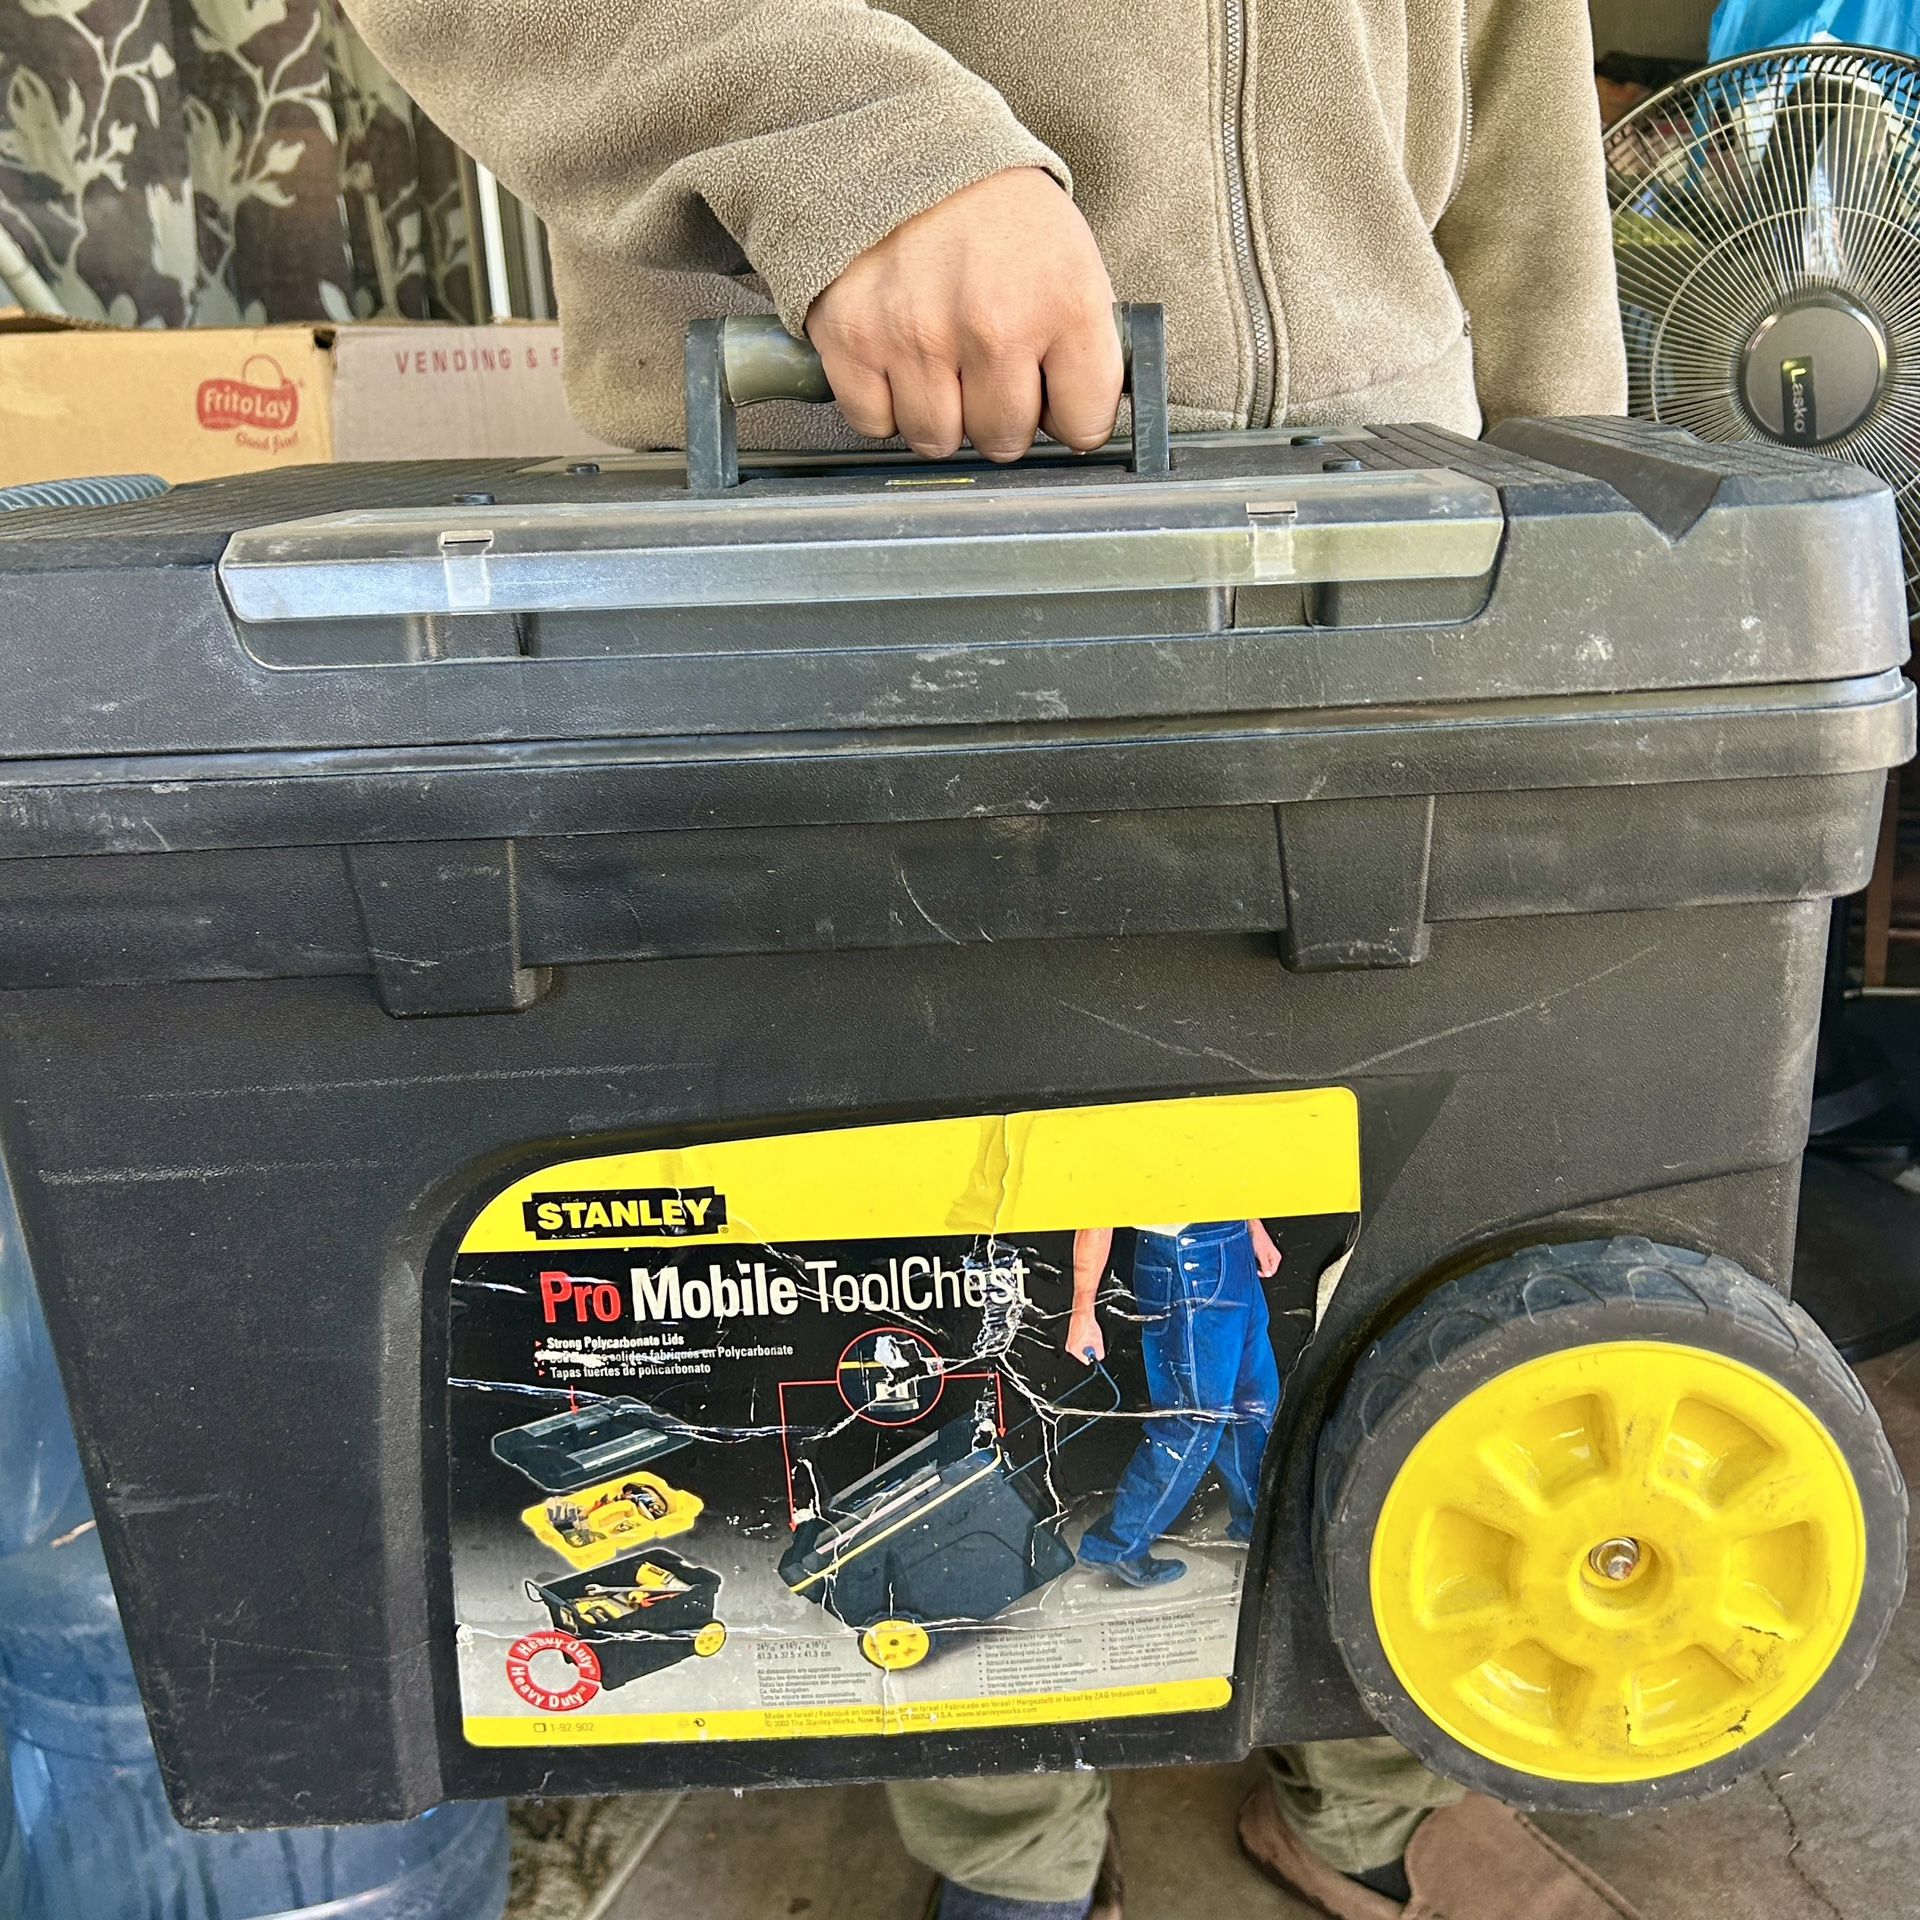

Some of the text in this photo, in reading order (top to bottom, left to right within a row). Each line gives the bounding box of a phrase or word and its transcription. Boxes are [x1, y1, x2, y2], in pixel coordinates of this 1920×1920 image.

[395, 347, 512, 374] VENDING
[1790, 368, 1807, 433] Lasko
[540, 1255, 1033, 1324] Pro Mobile ToolChest
[546, 1332, 685, 1352] Strong Polycarbonate Lids
[717, 1345, 793, 1361] Polycarbonate
[549, 1362, 712, 1381] Tapas fuertes de policarbonato
[516, 1636, 565, 1657] Heavy
[511, 1666, 546, 1706] Heavy
[794, 1711, 814, 1719] Israel
[805, 1718, 831, 1726] Stanley
[549, 1722, 594, 1733] 1-92-902
